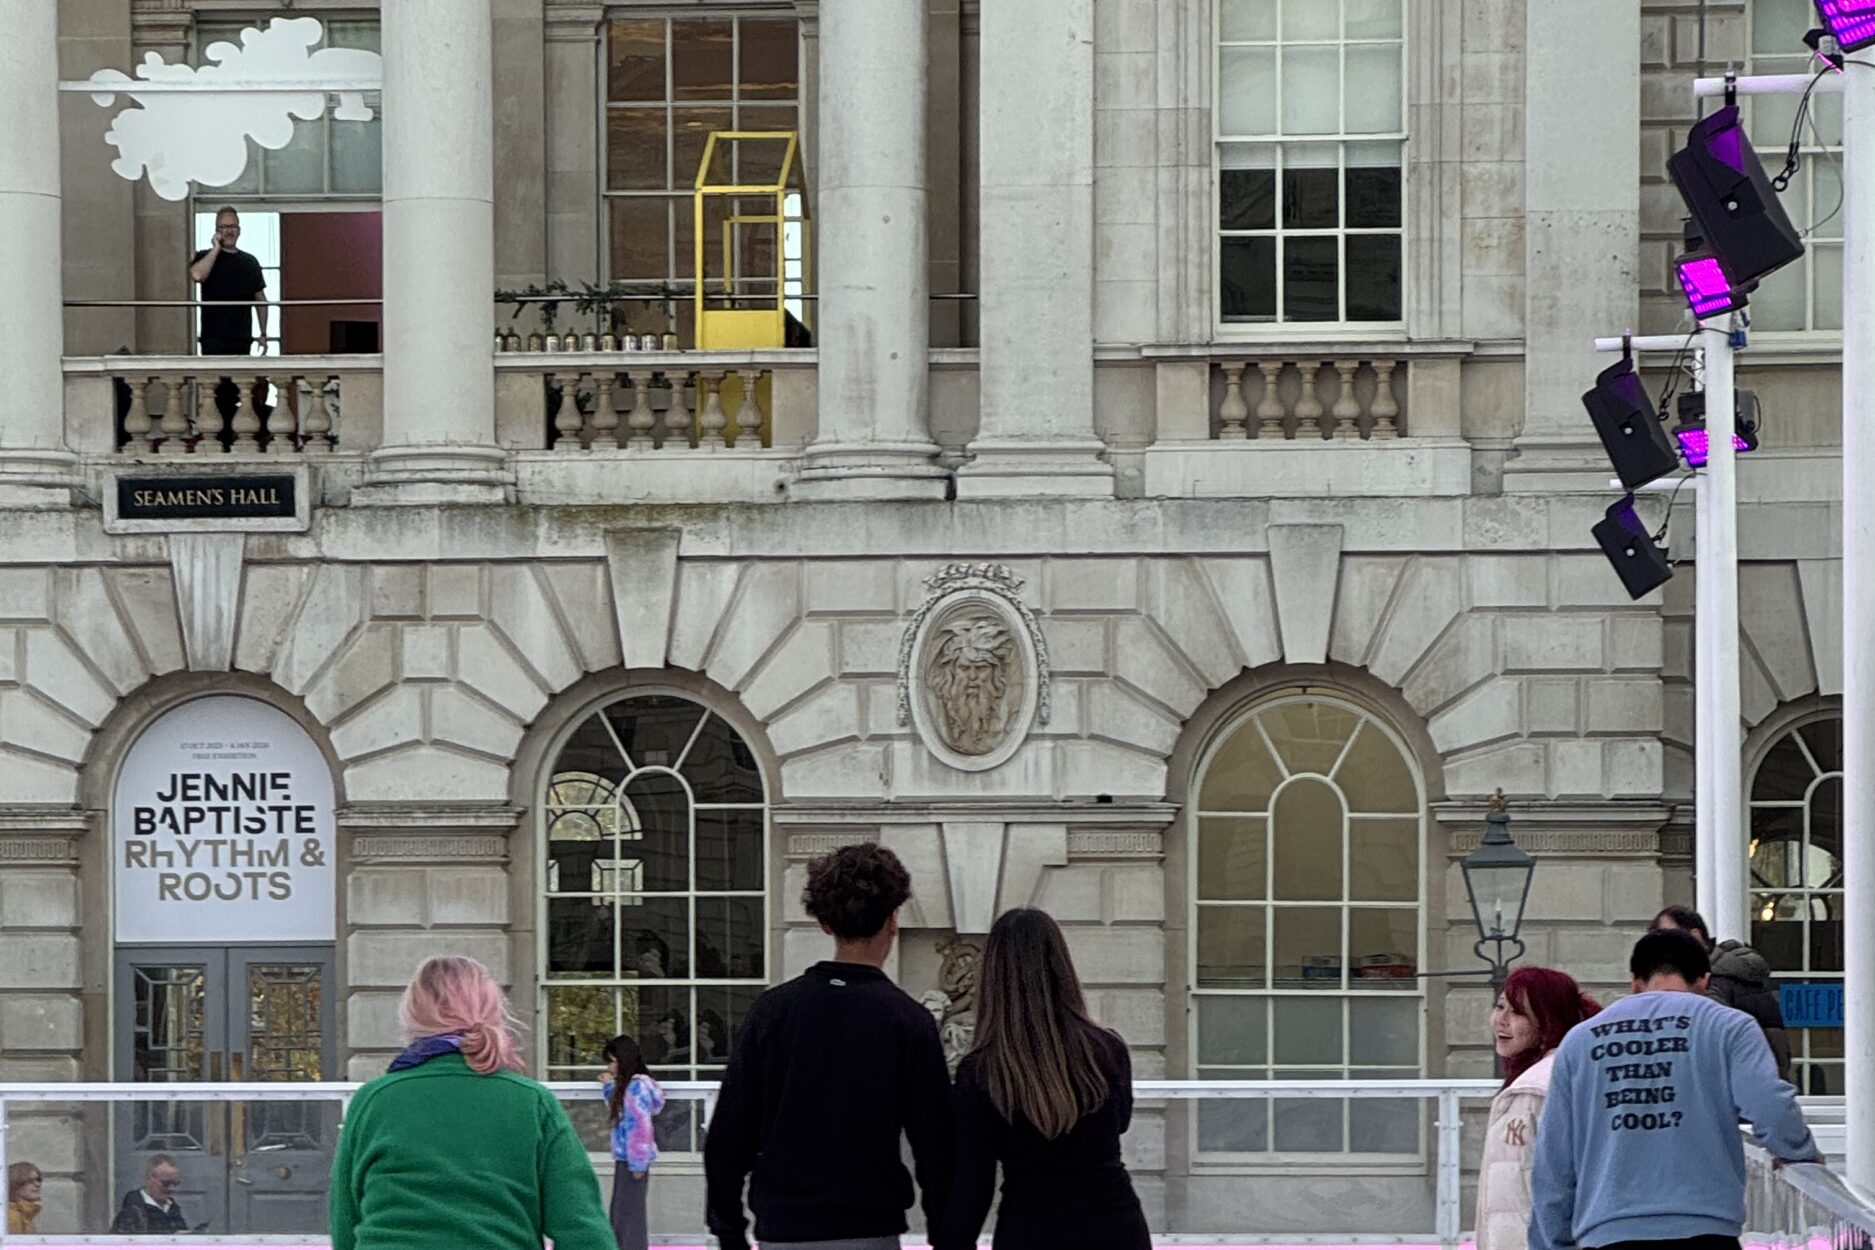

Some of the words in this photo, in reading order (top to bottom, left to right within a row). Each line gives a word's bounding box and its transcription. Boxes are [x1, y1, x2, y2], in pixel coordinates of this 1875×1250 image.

[134, 488, 223, 506] SEAMEN'S
[231, 488, 280, 504] HALL
[157, 773, 291, 802] JENNIE
[134, 806, 316, 835] BAPTISTE
[300, 838, 326, 866] &
[159, 872, 291, 901] ROOTS
[1785, 990, 1820, 1020] CAFE
[1590, 1016, 1691, 1038] WHAT'S
[1591, 1037, 1689, 1061] COOLER
[1606, 1062, 1672, 1082] THAN
[1605, 1086, 1676, 1109] BEING
[1505, 1118, 1526, 1146] NY
[1611, 1111, 1683, 1131] COOL?
